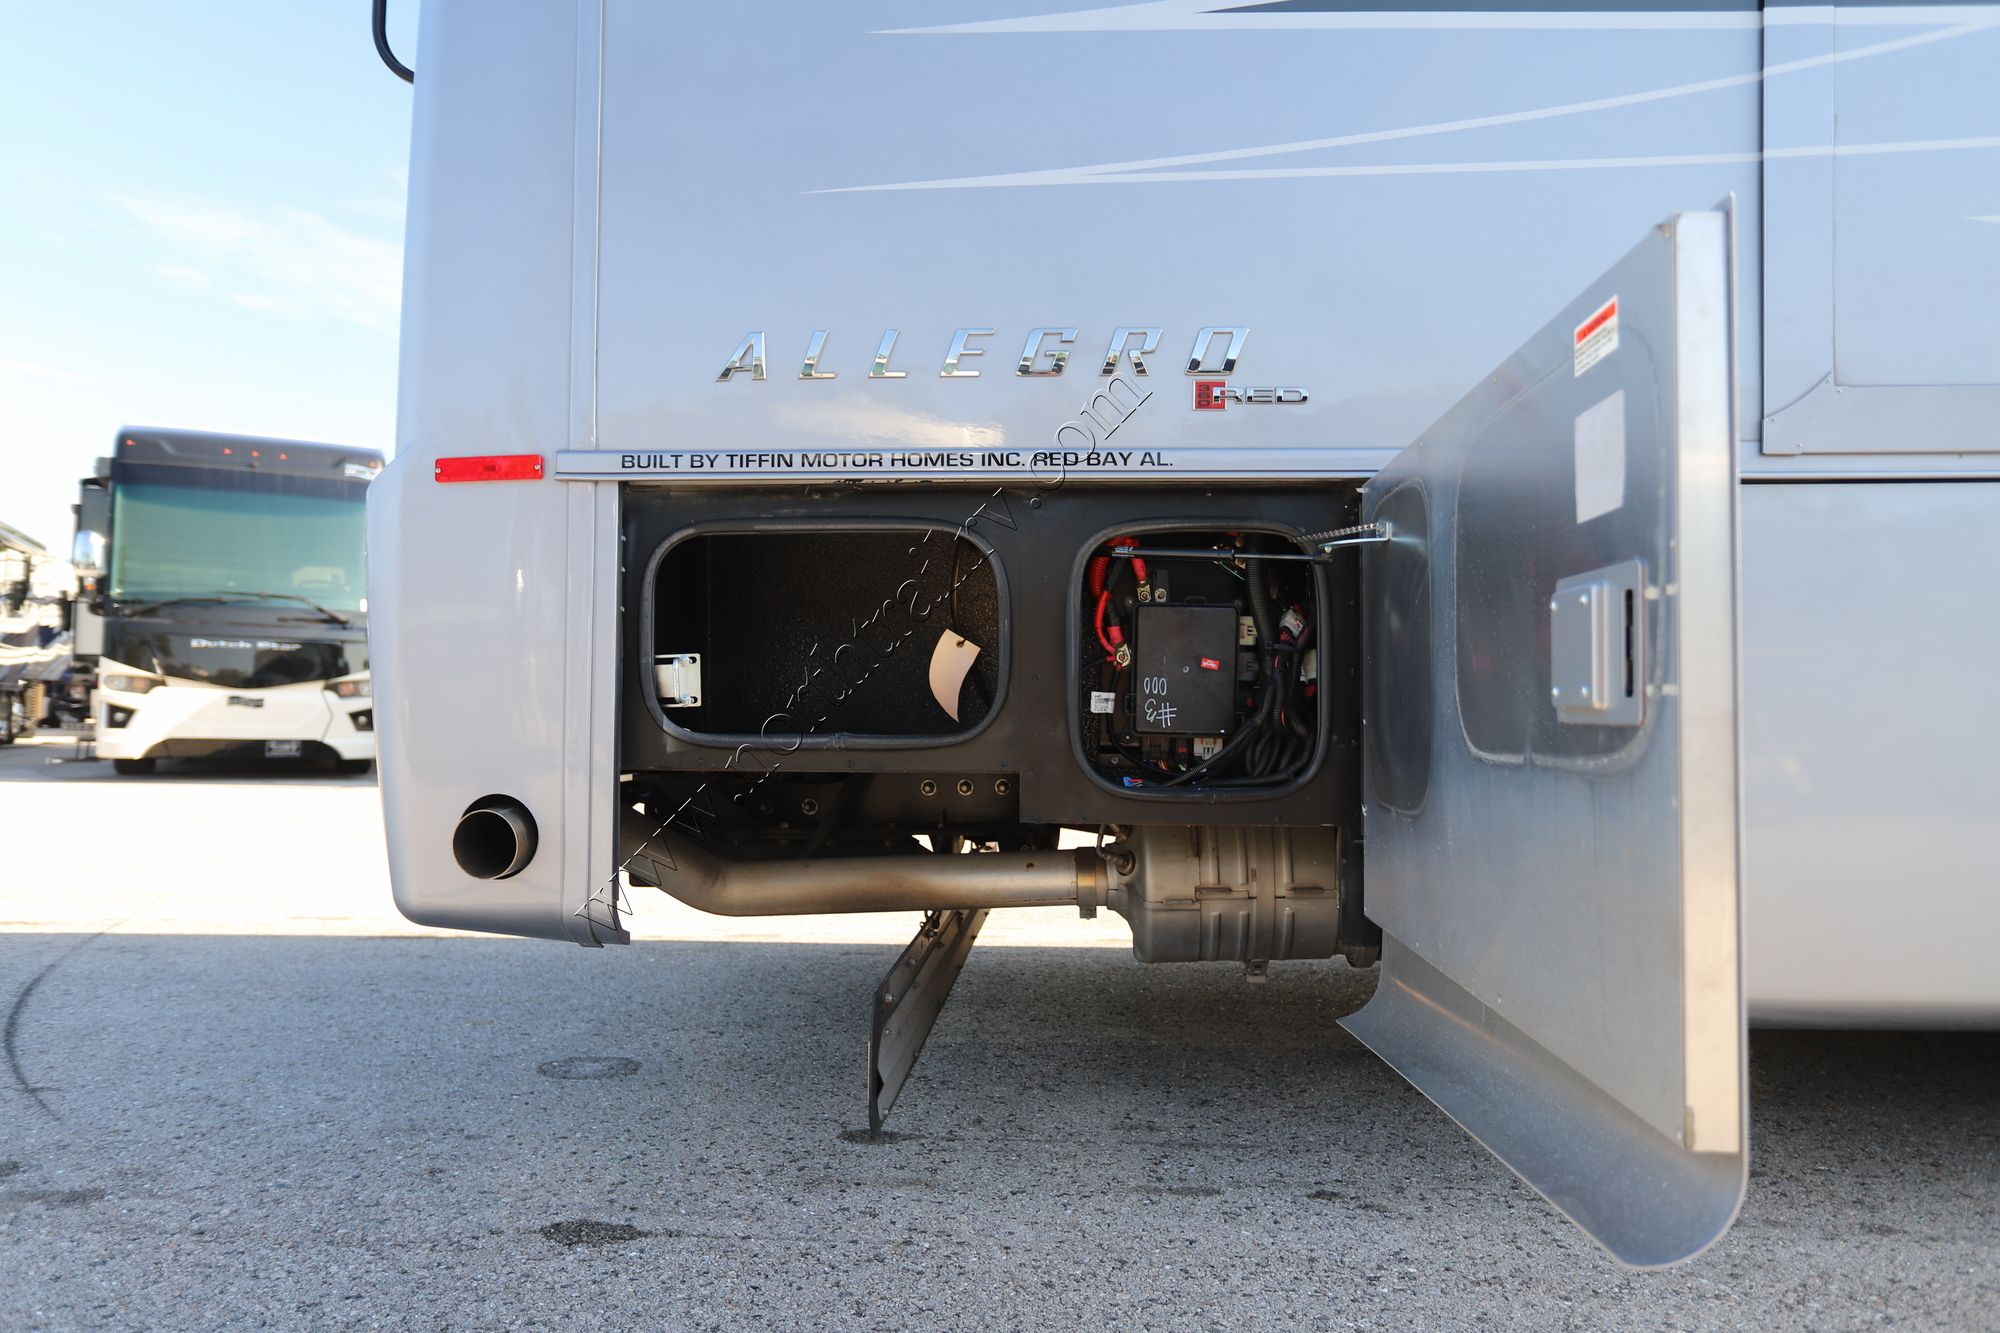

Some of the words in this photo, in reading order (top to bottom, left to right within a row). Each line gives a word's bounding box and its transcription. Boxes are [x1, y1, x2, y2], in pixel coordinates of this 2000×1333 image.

[716, 326, 1250, 382] ALLEGRO
[1212, 386, 1310, 405] RED
[621, 454, 683, 469] BUILT
[690, 454, 720, 468] BY
[726, 453, 793, 468] TIFFIN
[801, 453, 883, 468] MOTOR
[890, 452, 974, 467] HOMES
[981, 452, 1025, 467] INC.
[1033, 452, 1079, 467] RED
[1086, 452, 1133, 467] BAY
[1139, 451, 1174, 467] AL.
